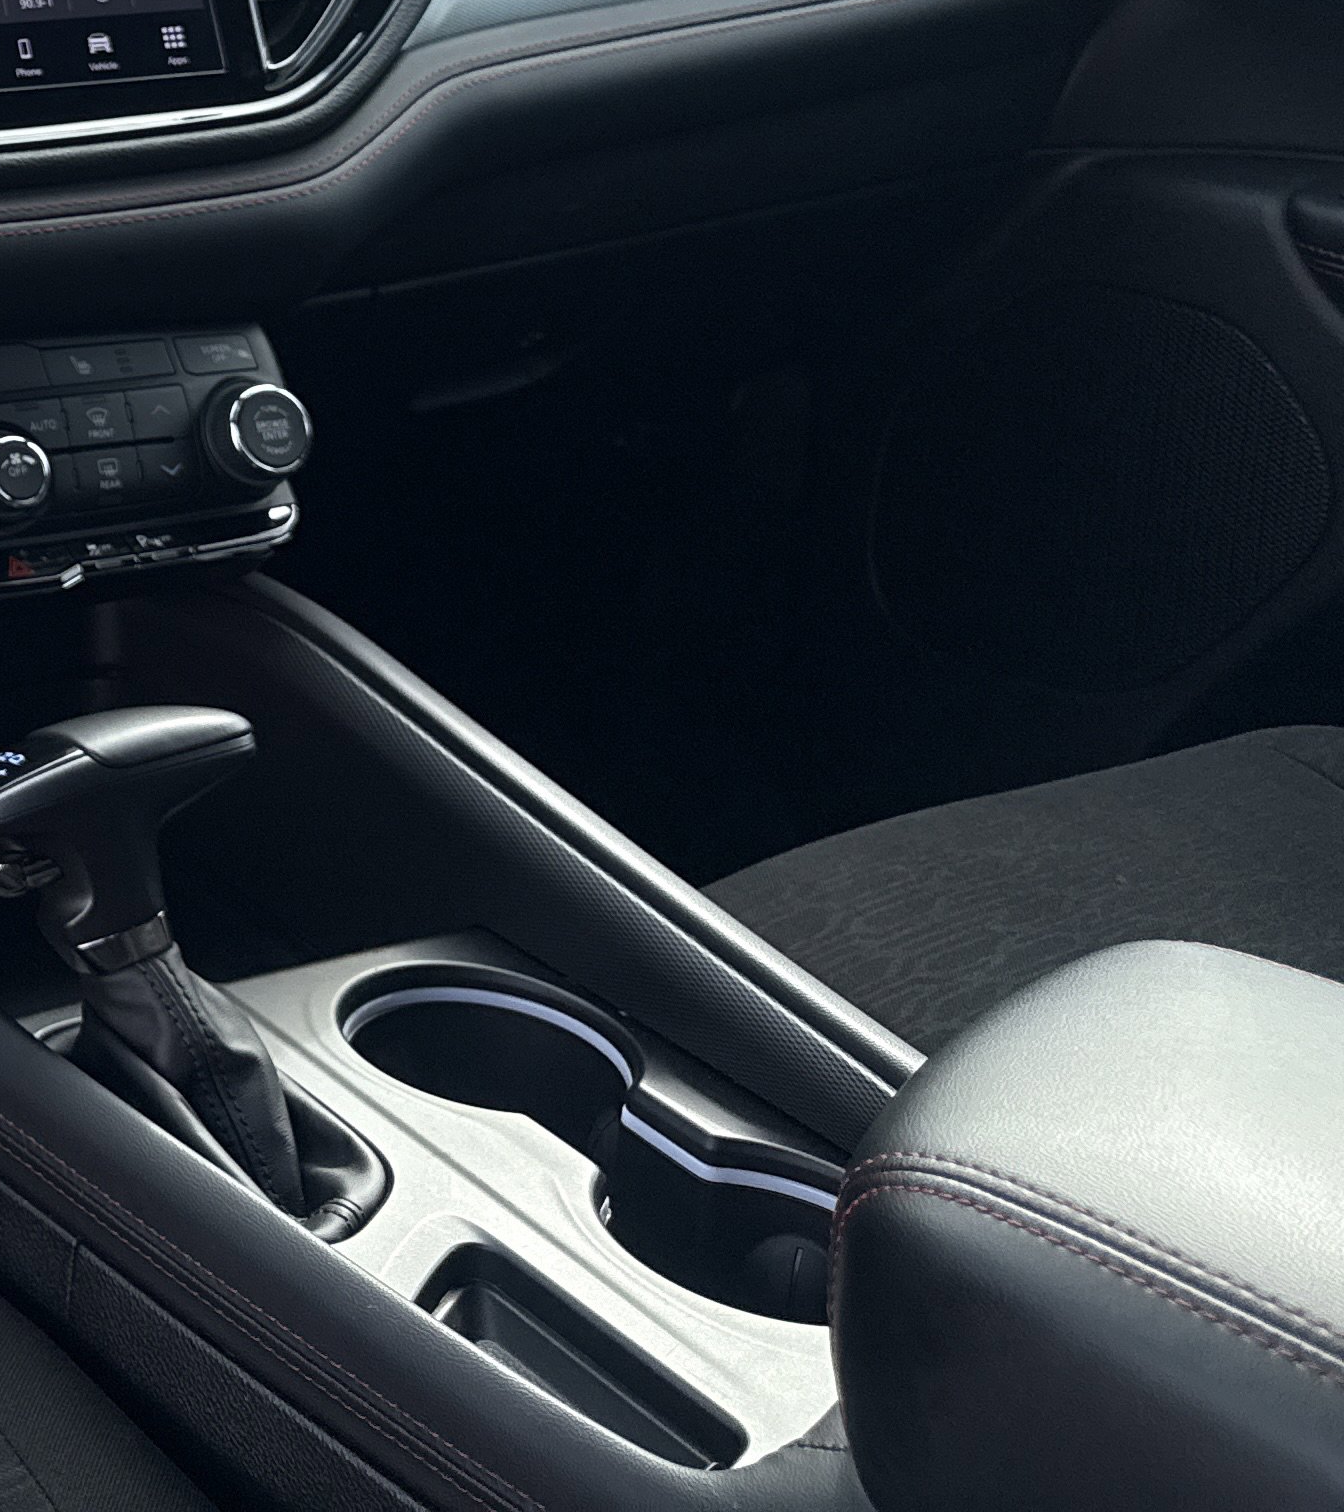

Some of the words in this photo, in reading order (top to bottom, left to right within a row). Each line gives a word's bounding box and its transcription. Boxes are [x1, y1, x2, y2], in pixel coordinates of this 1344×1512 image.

[88, 60, 120, 73] Vehicle
[167, 55, 191, 67] Apps
[15, 66, 43, 78] Phone
[30, 418, 57, 432] AUTO
